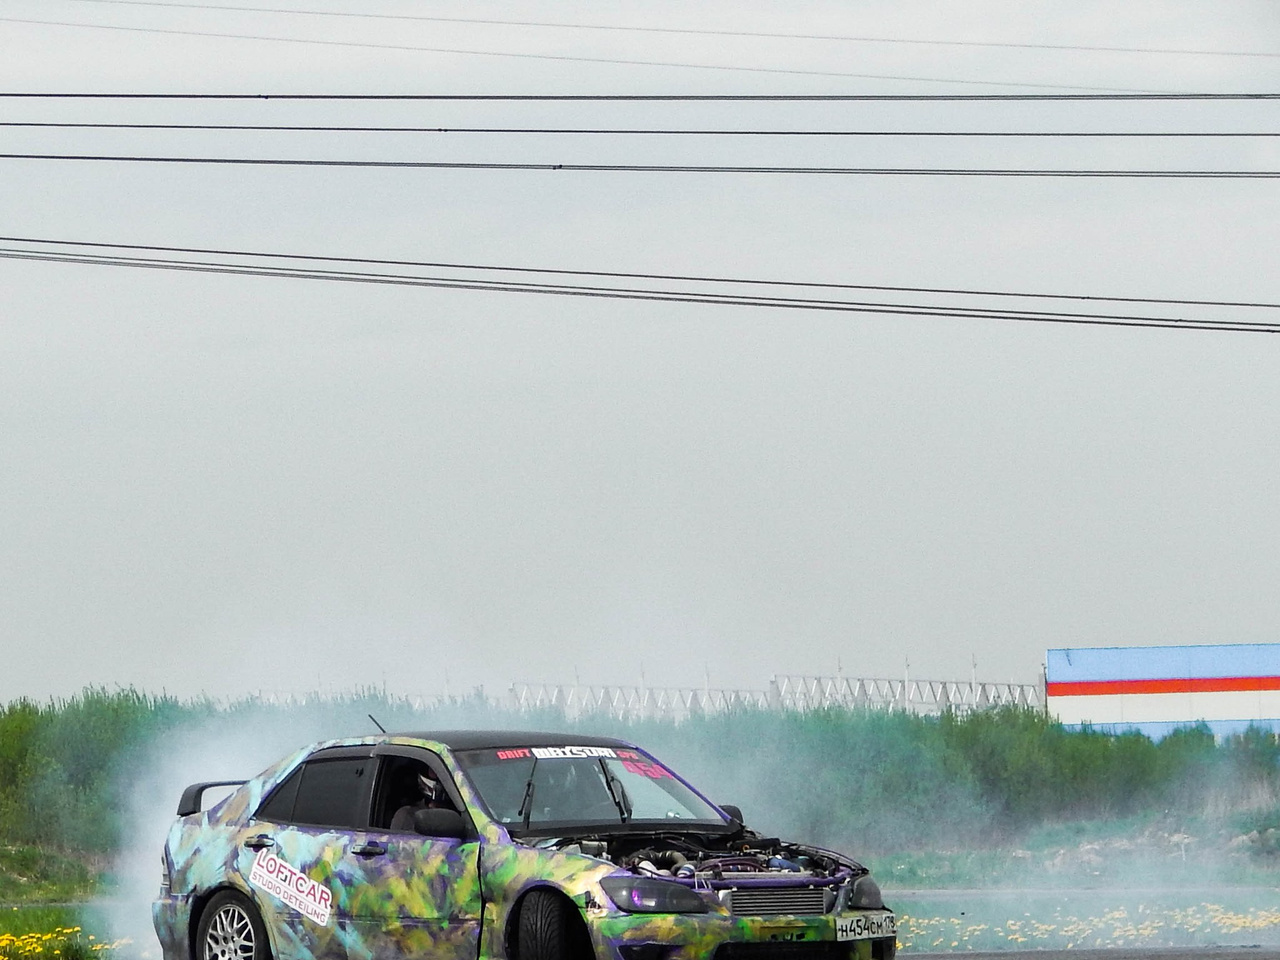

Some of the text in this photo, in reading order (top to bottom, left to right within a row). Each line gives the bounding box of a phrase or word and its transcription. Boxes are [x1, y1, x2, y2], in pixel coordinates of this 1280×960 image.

[496, 748, 532, 760] DRIFT
[251, 870, 326, 924] STUDIO DETEILING
[256, 850, 331, 909] LOFTCAR
